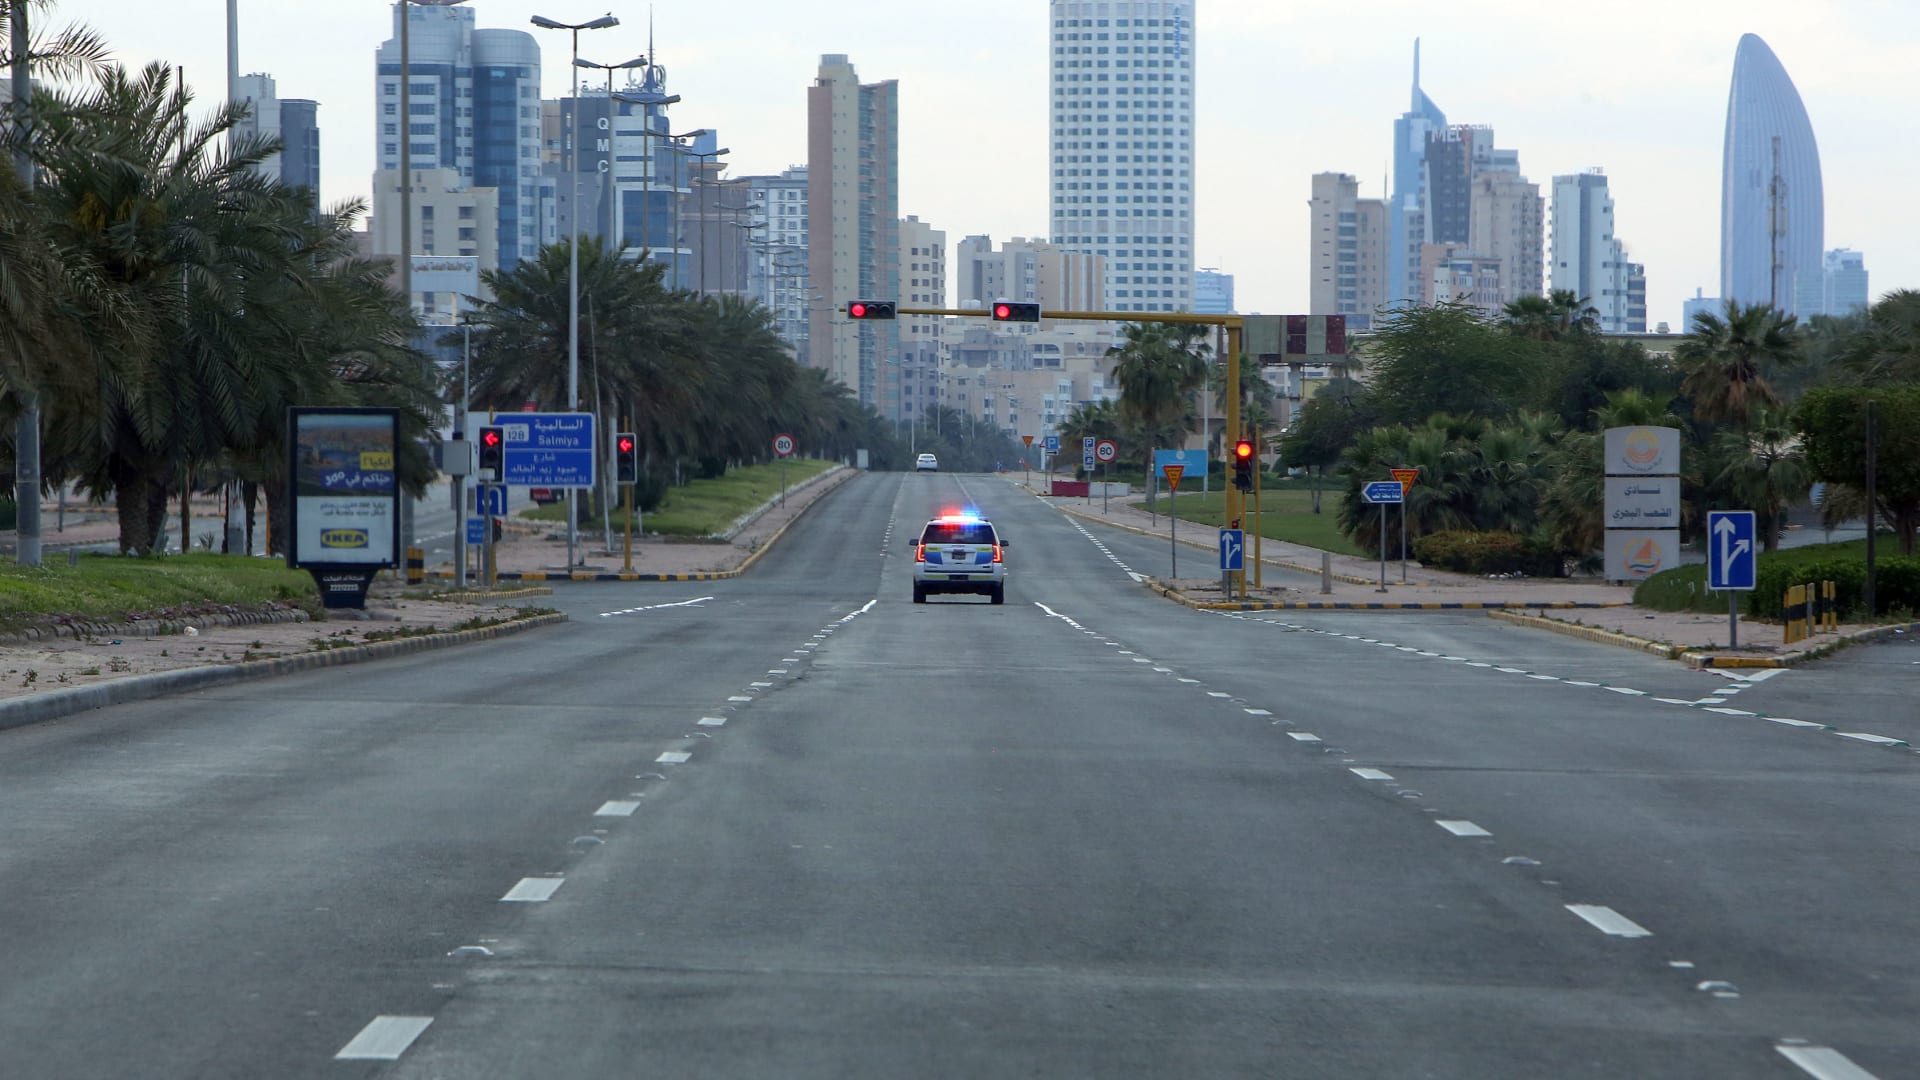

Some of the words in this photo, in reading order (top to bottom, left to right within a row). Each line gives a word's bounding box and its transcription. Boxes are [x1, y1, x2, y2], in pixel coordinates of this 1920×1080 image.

[534, 419, 584, 432] السالمية
[508, 430, 525, 441] 128
[538, 434, 579, 447] Salmiya
[778, 440, 790, 449] 80
[1099, 447, 1112, 455] 80
[325, 534, 364, 543] IKEA
